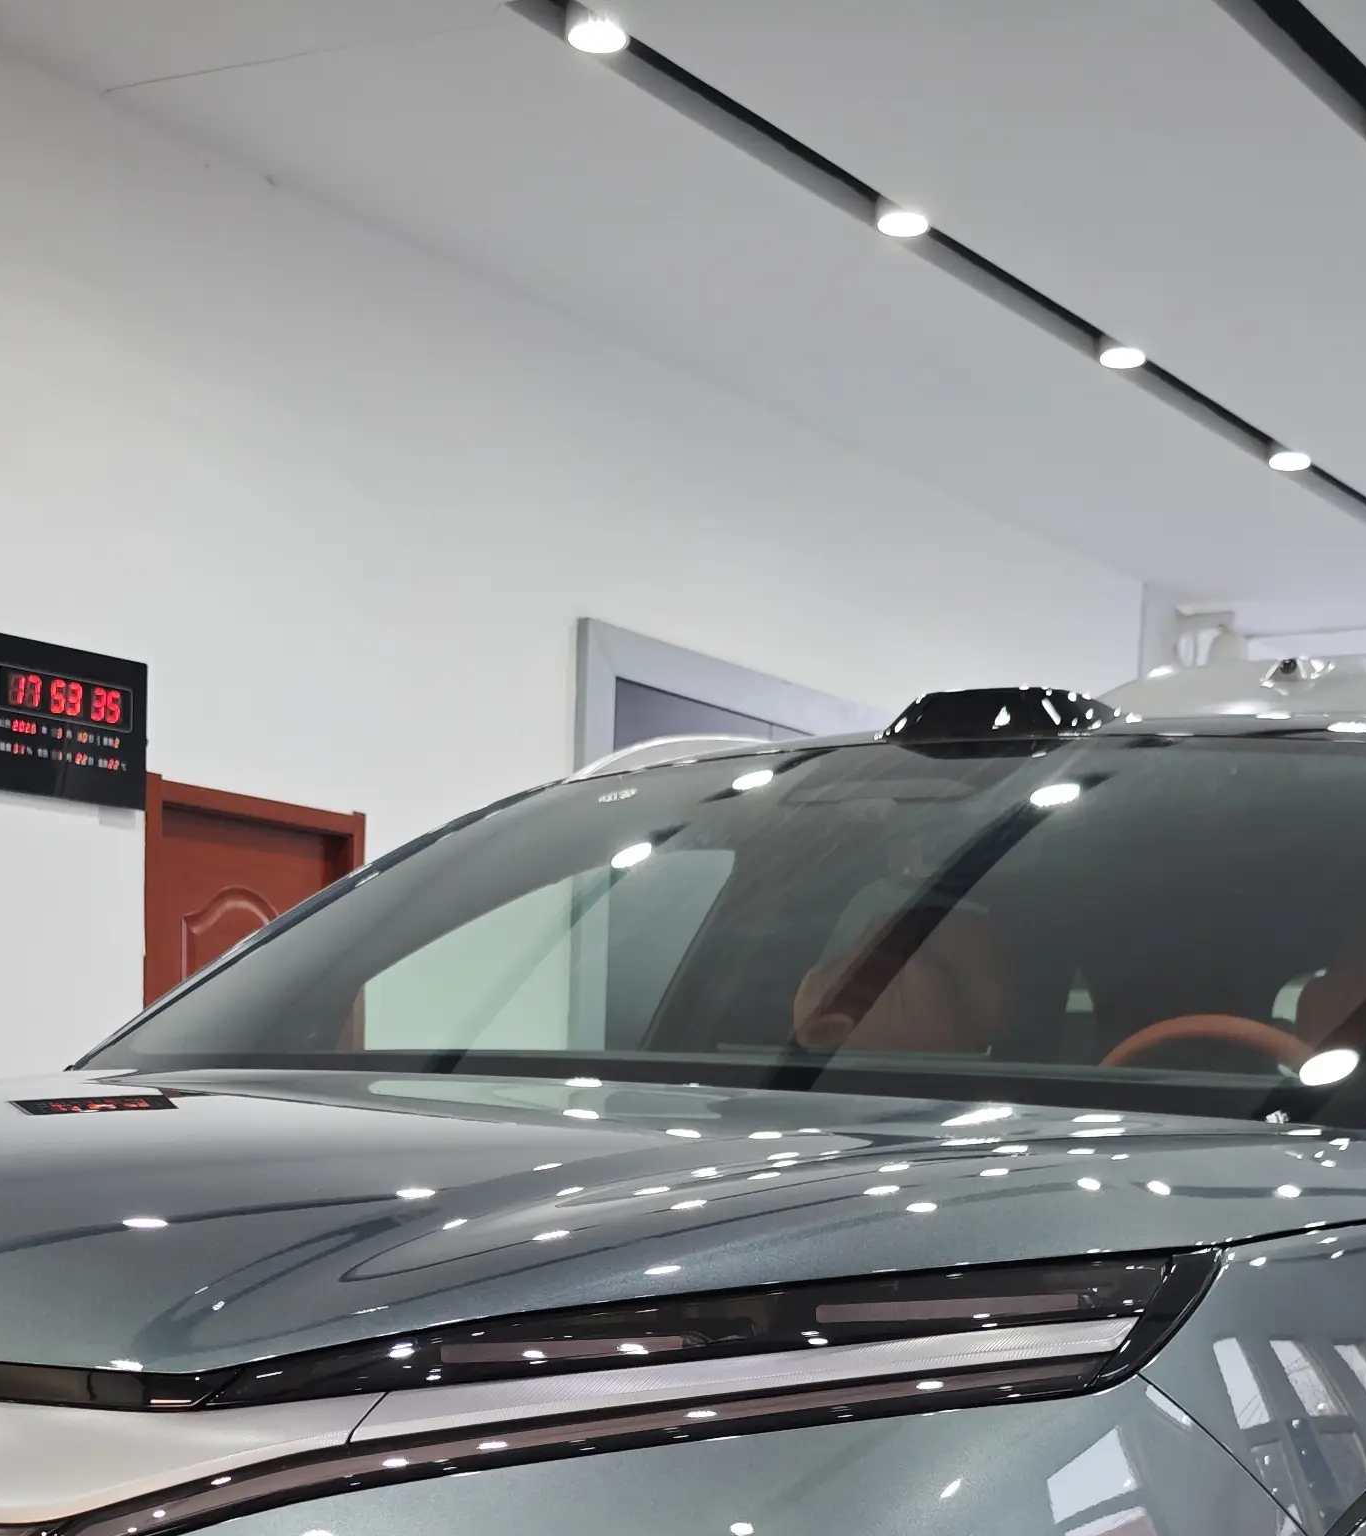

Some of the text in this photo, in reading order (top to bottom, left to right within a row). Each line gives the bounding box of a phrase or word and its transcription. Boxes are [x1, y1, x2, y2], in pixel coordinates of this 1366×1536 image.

[17, 674, 121, 724] 17 53 35
